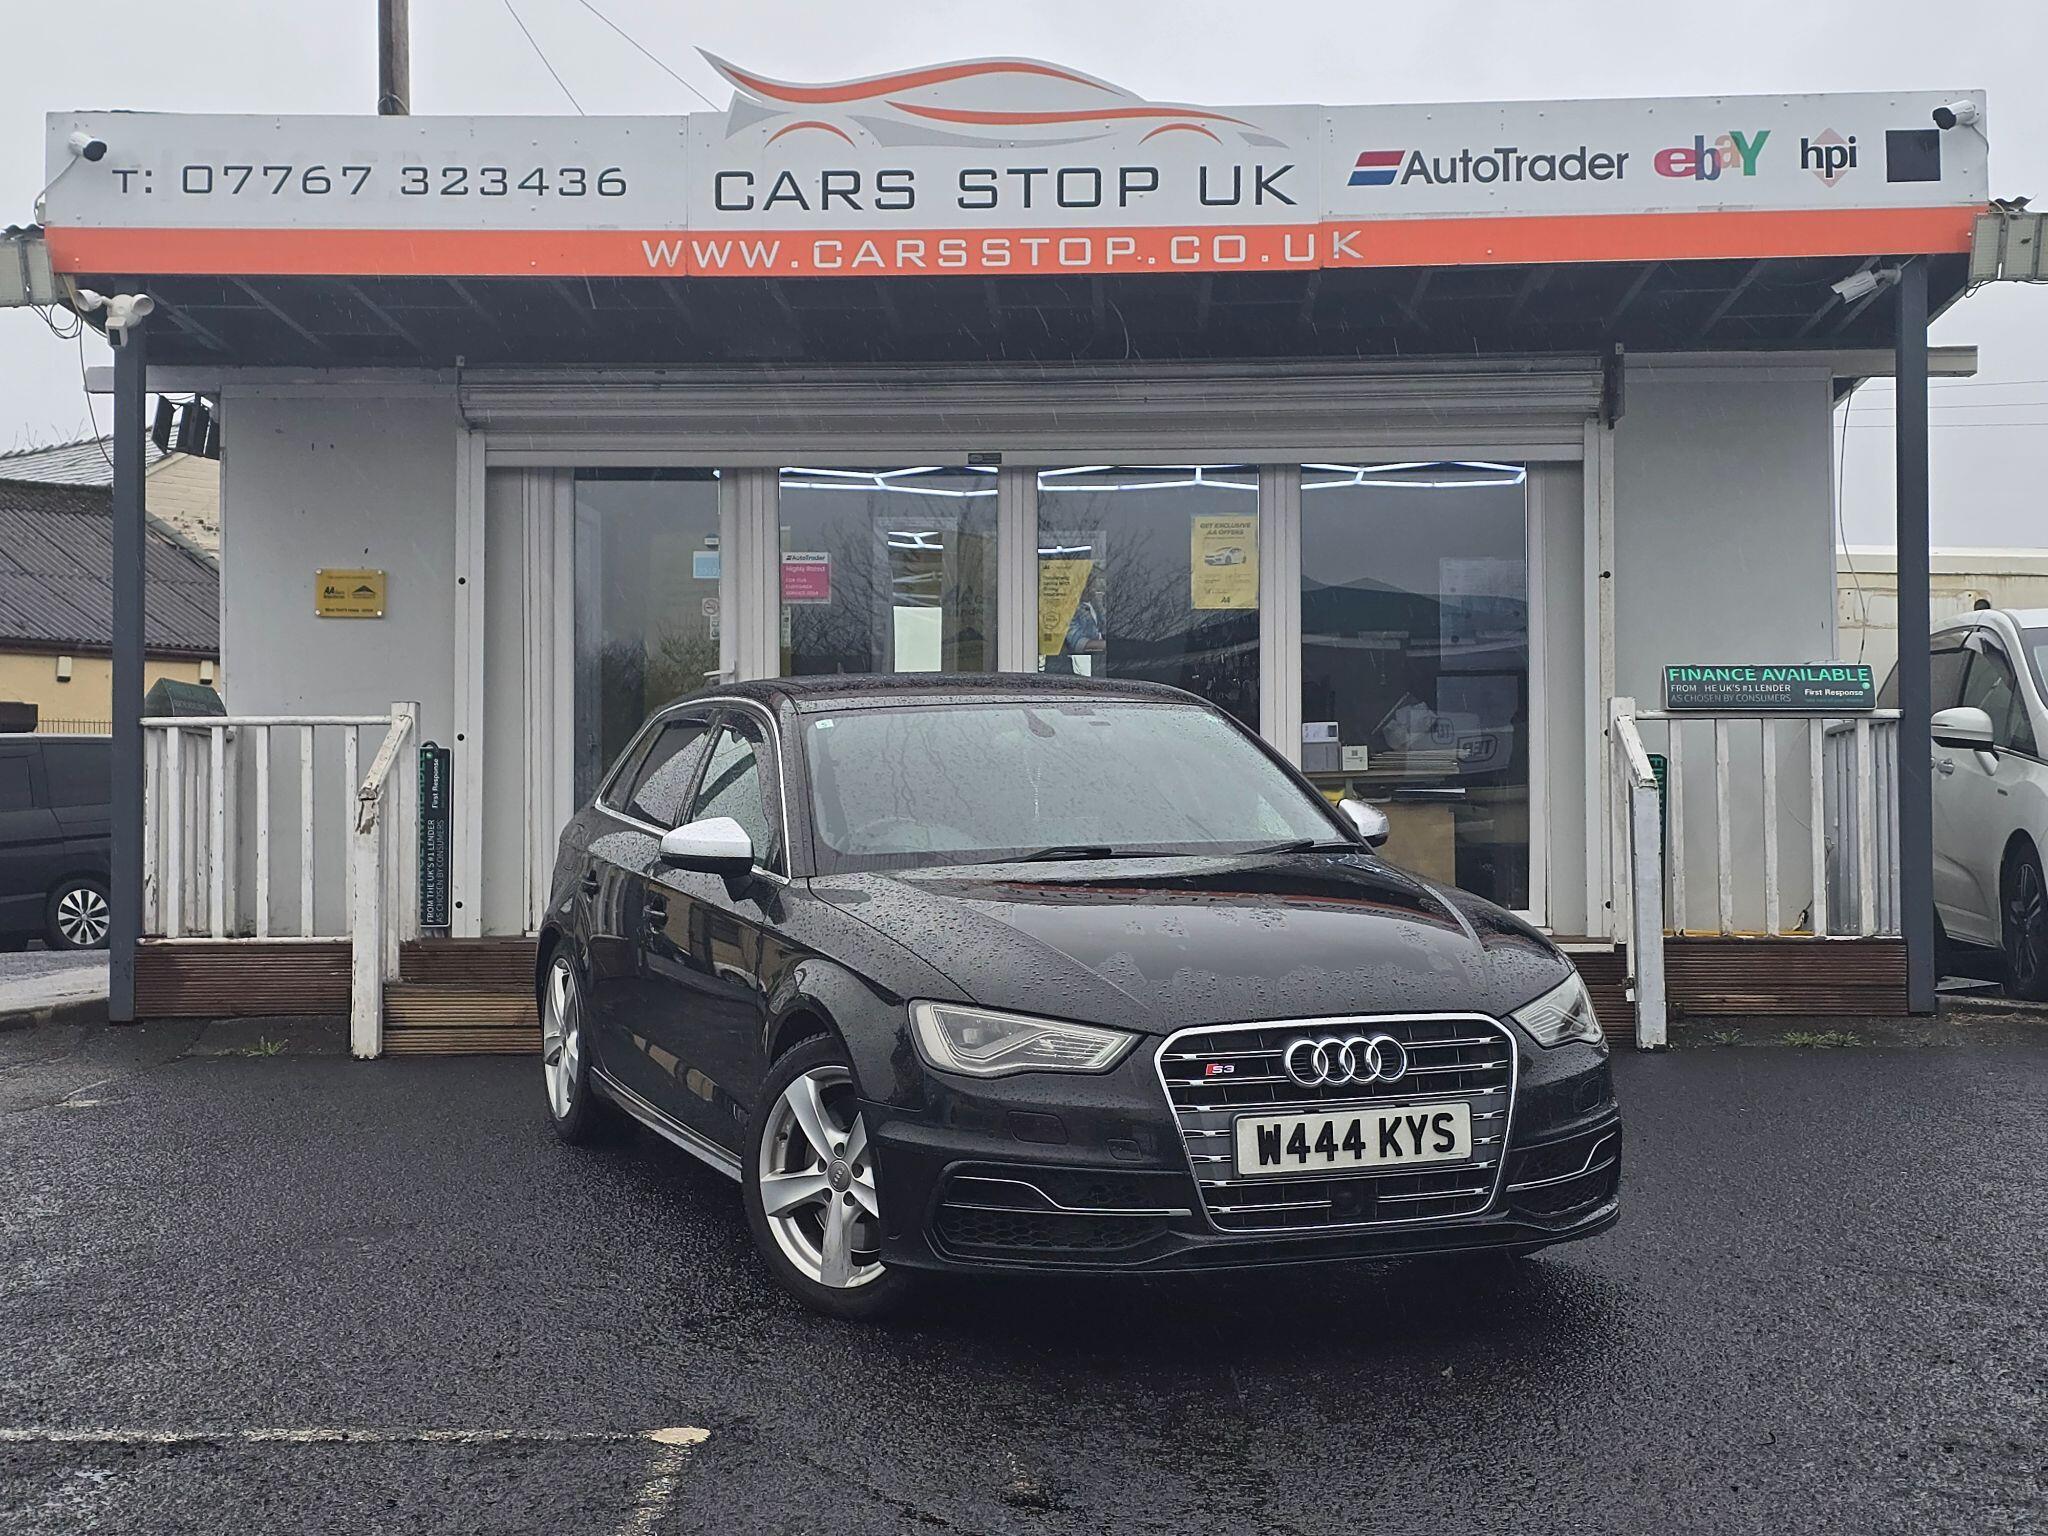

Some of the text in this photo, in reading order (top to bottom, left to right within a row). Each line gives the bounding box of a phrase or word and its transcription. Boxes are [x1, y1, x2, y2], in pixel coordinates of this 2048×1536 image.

[1400, 146, 1629, 185] AutoTrader
[1800, 135, 1857, 179] hpi
[112, 165, 627, 197] T: 07767 323436
[714, 164, 1298, 211] CARS STOP UK
[641, 229, 1364, 270] WWW.CARSSTOP.CO.UK
[1668, 668, 1870, 681] FINANCE AVAILABLE
[1671, 684, 1697, 692] FROM
[1719, 684, 1741, 692] UK'S
[1742, 684, 1753, 692] #1
[1755, 684, 1791, 692] LENDER
[1671, 693, 1792, 702] AS CHOSEN BY CONSUMERS
[1804, 688, 1864, 697] First Response
[427, 819, 435, 851] LENDER
[436, 820, 444, 868] CONSUMERS
[427, 862, 435, 880] UK'S
[427, 881, 435, 898] THE
[436, 880, 444, 911] CHOSEN
[436, 912, 444, 923] AS
[1211, 1064, 1235, 1074] S3
[1256, 1112, 1456, 1166] W444 KYS
